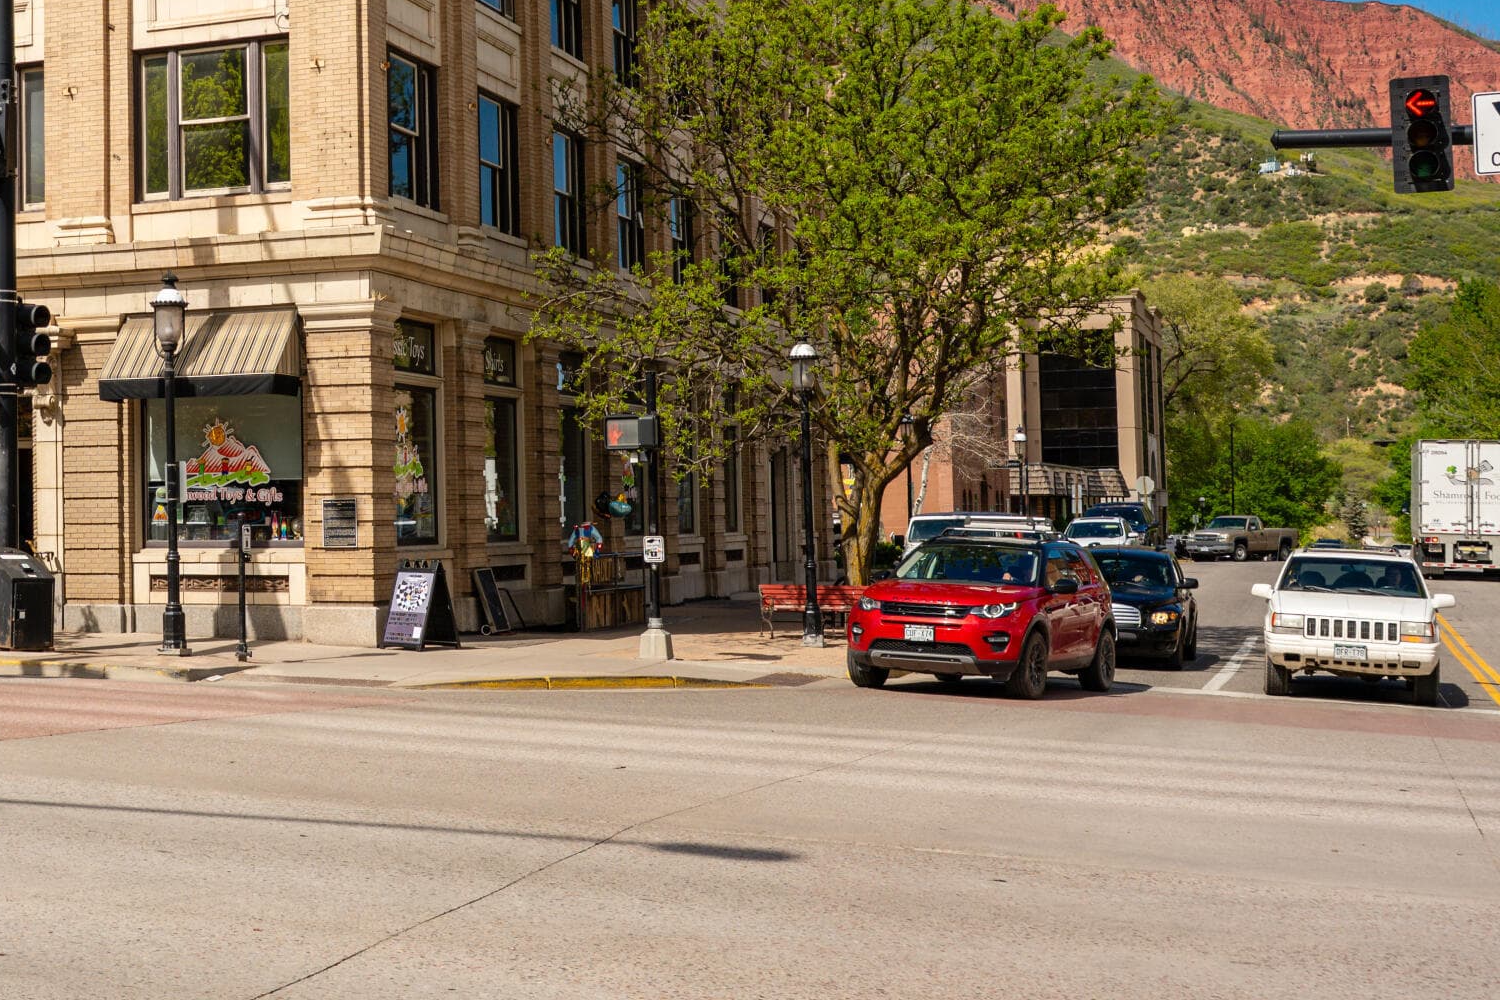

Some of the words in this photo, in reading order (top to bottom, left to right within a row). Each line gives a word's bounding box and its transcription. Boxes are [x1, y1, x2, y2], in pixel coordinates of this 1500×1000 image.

[408, 336, 425, 367] Toys
[219, 486, 244, 505] Toys
[245, 487, 257, 502] &
[257, 486, 284, 507] Gifts
[1433, 490, 1479, 499] Shamrok
